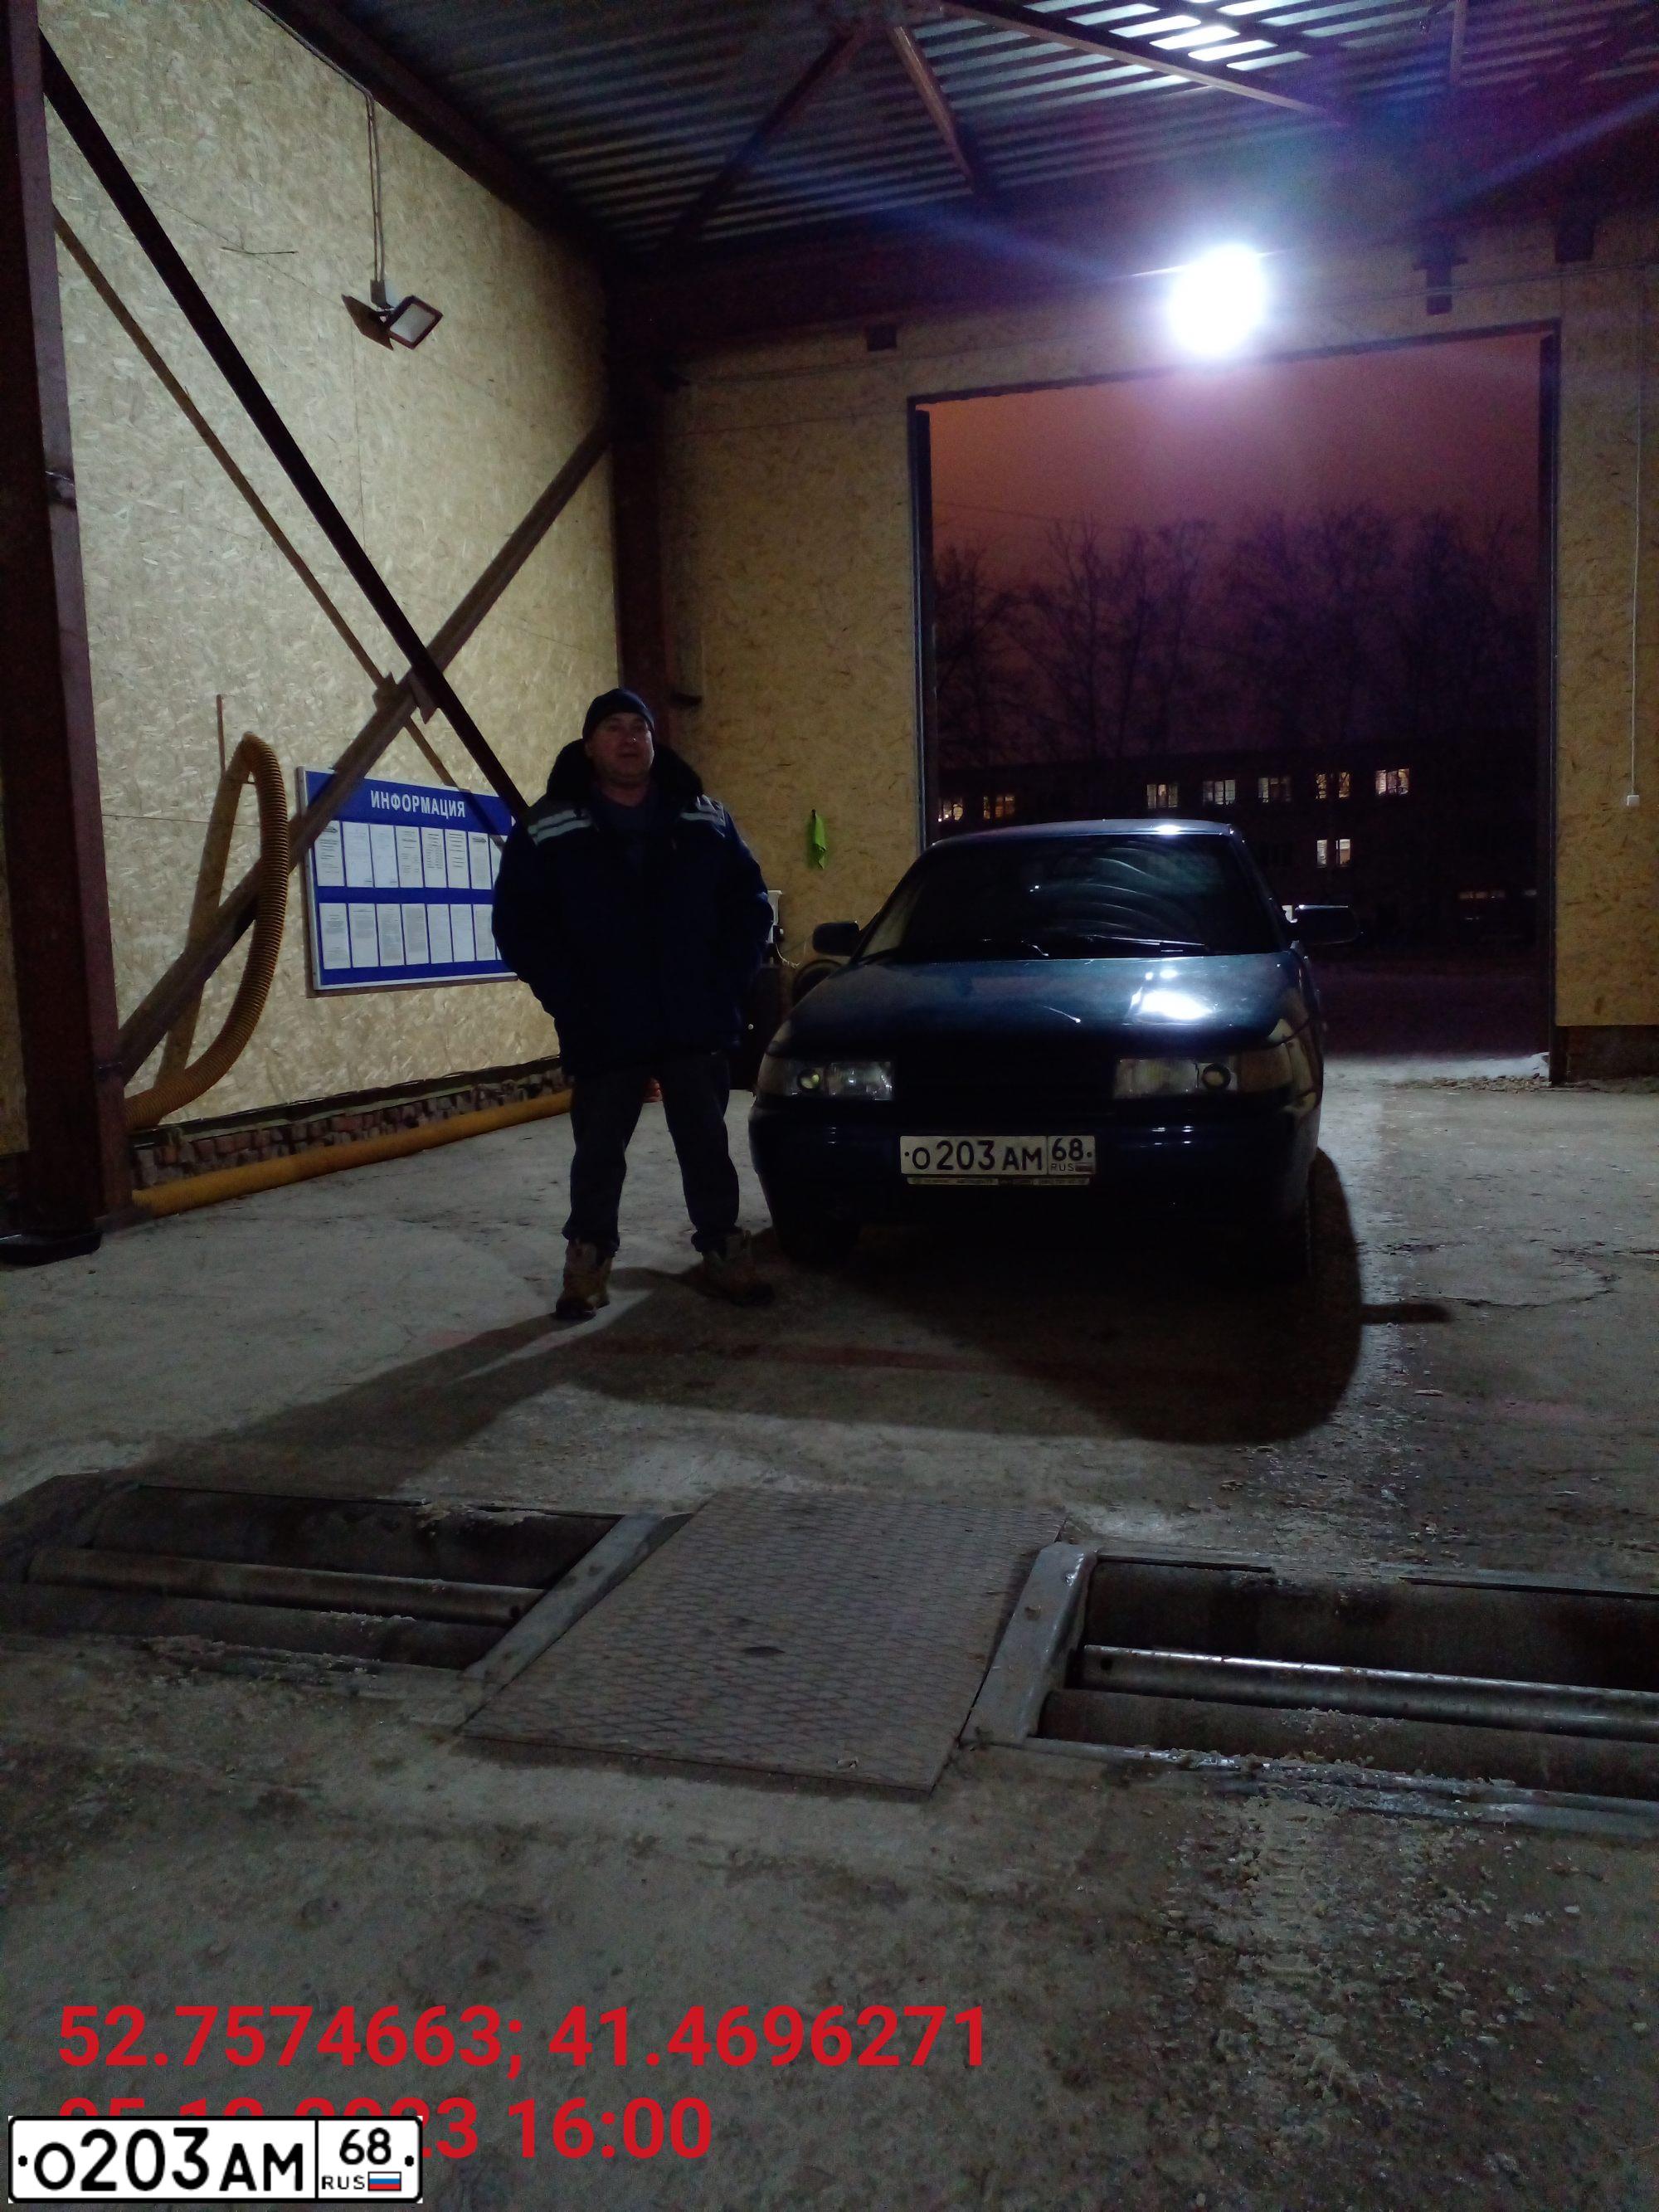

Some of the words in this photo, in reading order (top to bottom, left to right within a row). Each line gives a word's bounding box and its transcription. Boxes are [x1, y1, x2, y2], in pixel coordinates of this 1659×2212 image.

[371, 790, 465, 819] ИНФОРМАЦИЯ
[1051, 1138, 1084, 1162] 68
[1051, 1162, 1074, 1172] RUS
